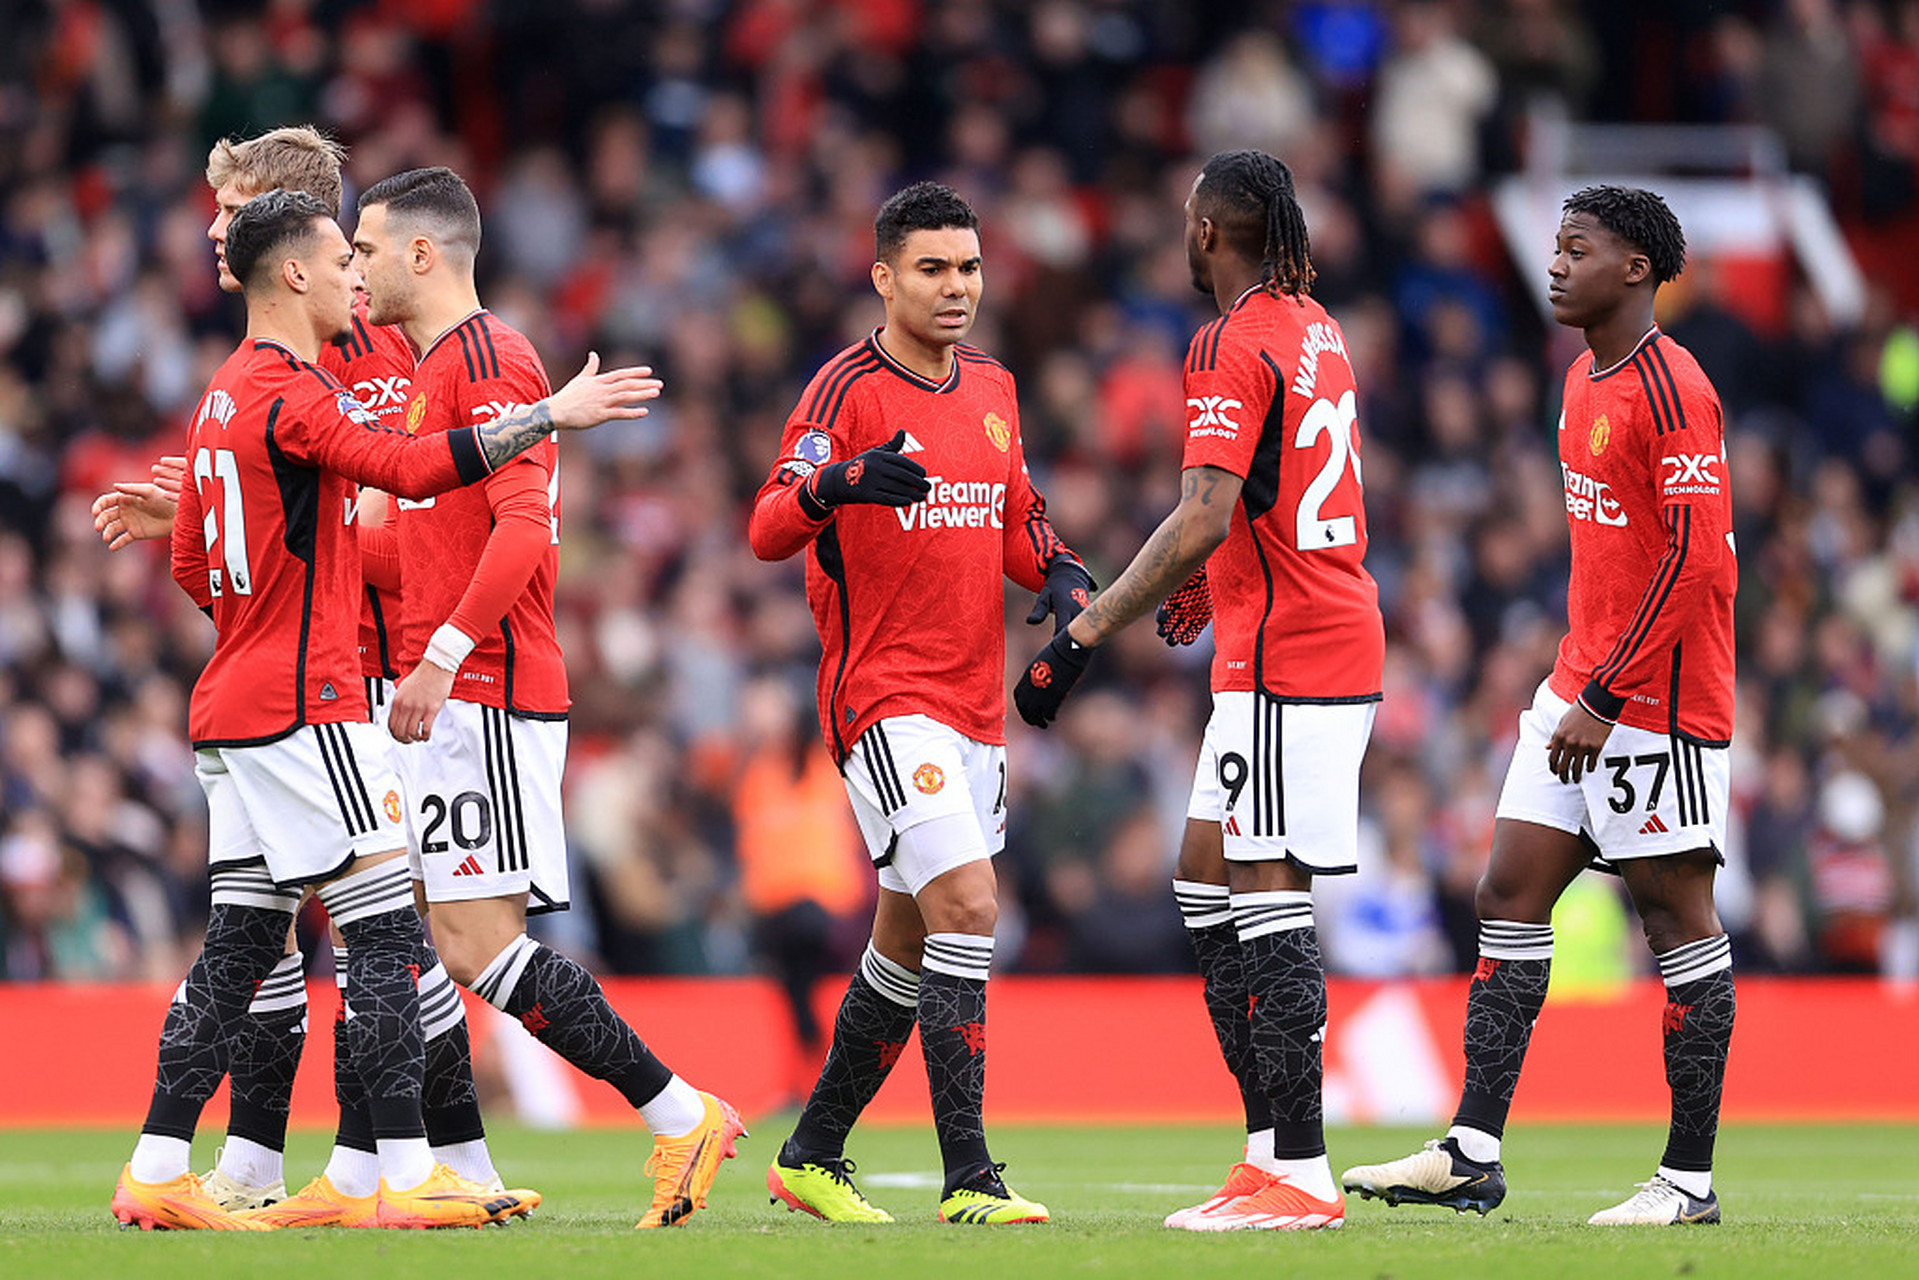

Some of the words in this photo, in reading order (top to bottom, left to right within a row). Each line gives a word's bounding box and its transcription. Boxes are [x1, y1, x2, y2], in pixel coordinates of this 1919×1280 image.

[1187, 395, 1243, 430] DXC
[1661, 453, 1720, 485] DXC
[923, 476, 991, 504] Team
[1663, 485, 1720, 496] TECHNOLOGY
[895, 501, 990, 531] Viewer
[1604, 752, 1670, 815] 37
[420, 790, 492, 854] 20
